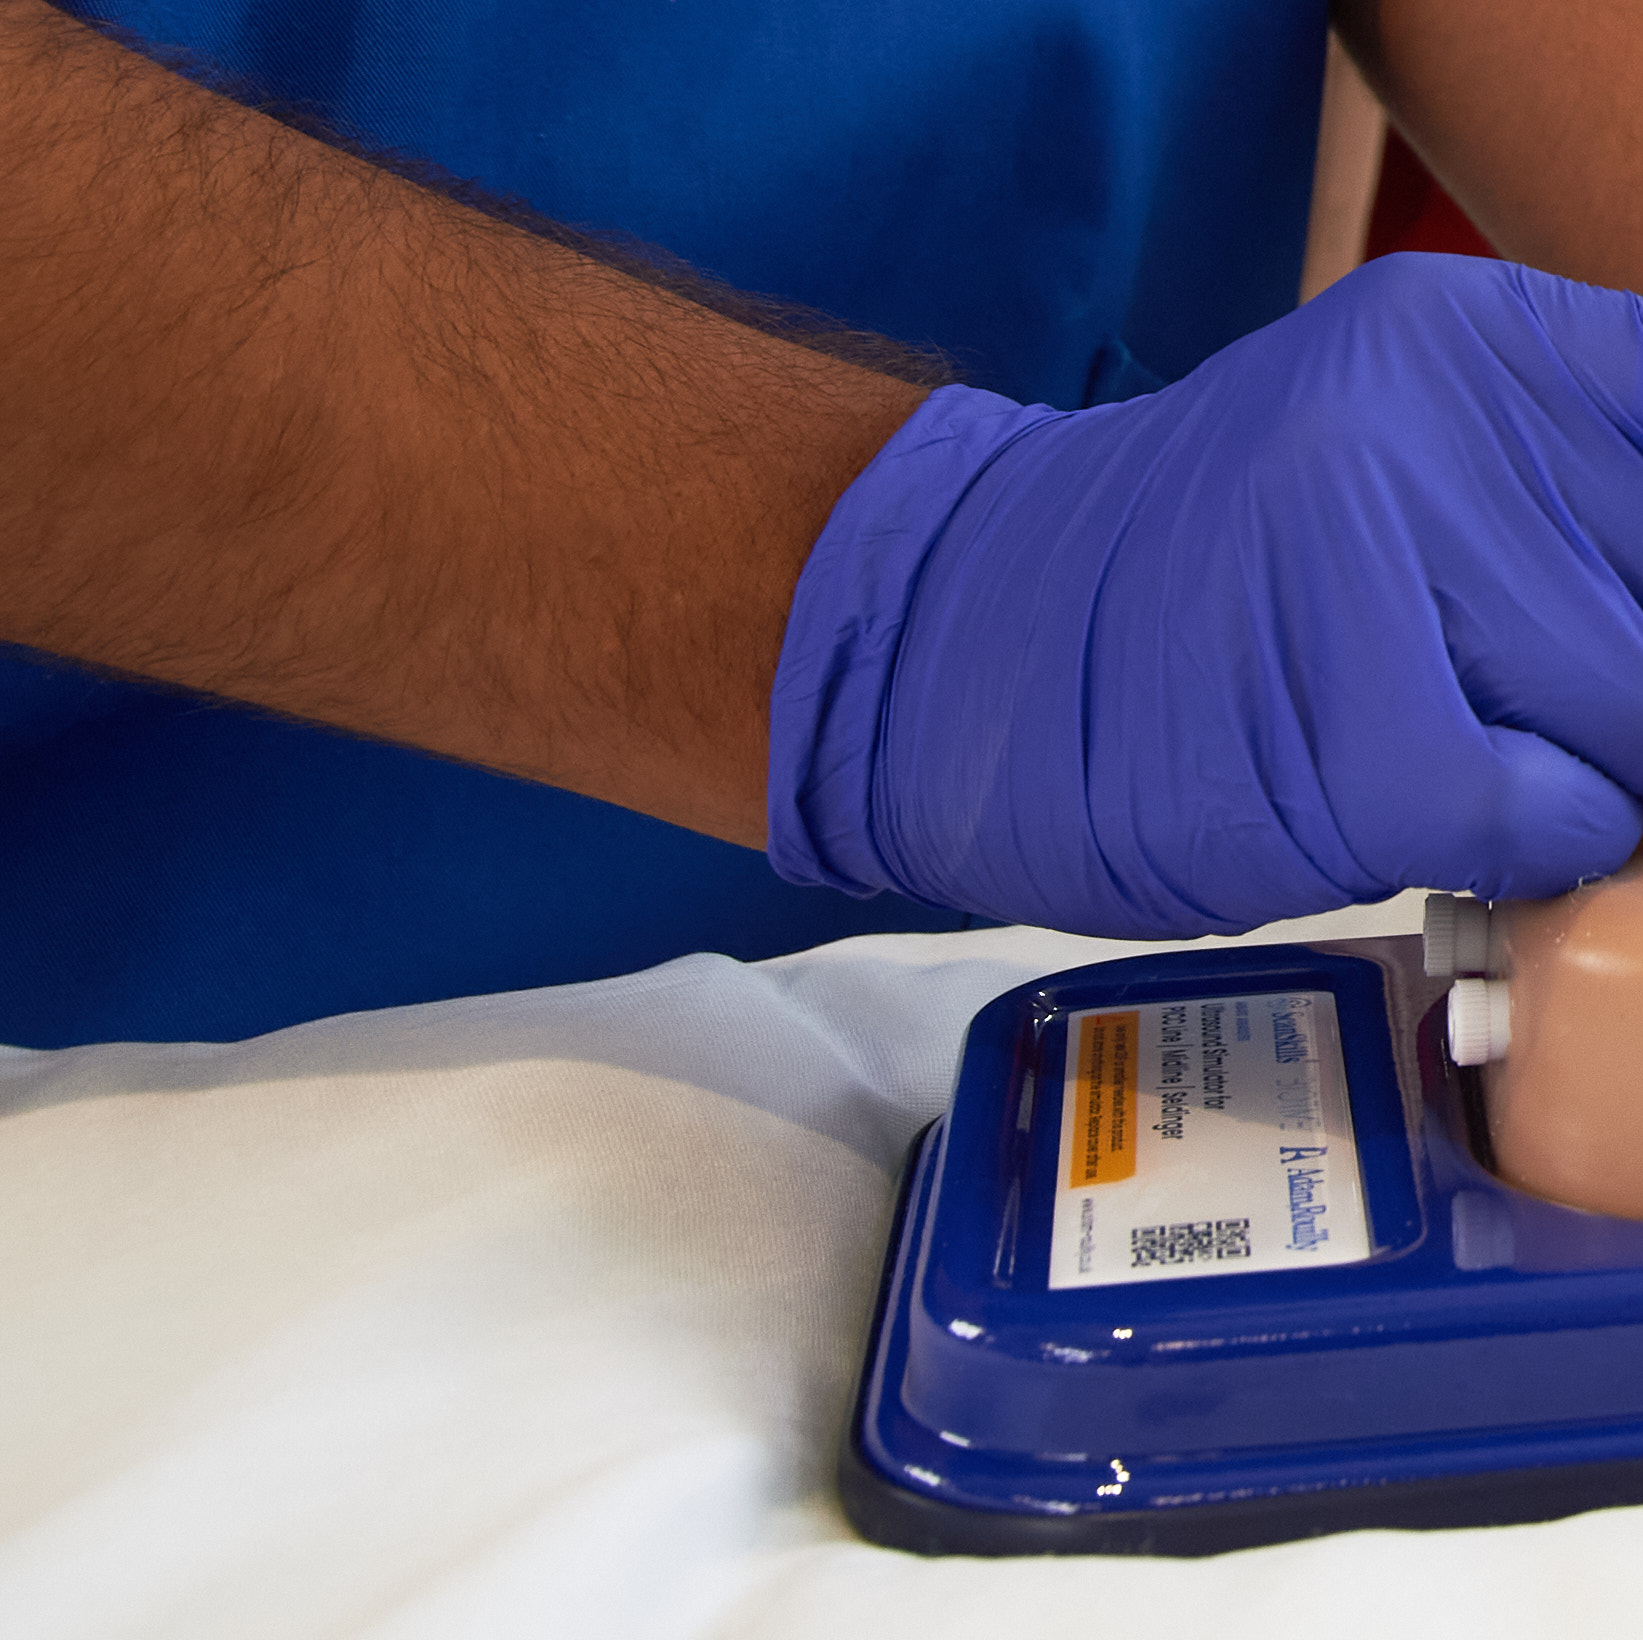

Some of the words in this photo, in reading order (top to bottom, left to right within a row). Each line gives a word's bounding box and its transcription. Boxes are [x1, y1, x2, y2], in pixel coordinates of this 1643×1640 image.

[1161, 1006, 1186, 1025] PICC
[1161, 1026, 1188, 1042] Line
[1201, 1003, 1228, 1047] Ultrasound
[1272, 1012, 1309, 1063] ScanSkills
[1161, 1049, 1190, 1084] Midline
[1203, 1048, 1230, 1094] Simulator
[1152, 1091, 1190, 1139] Seldinger
[1204, 1095, 1232, 1109] for
